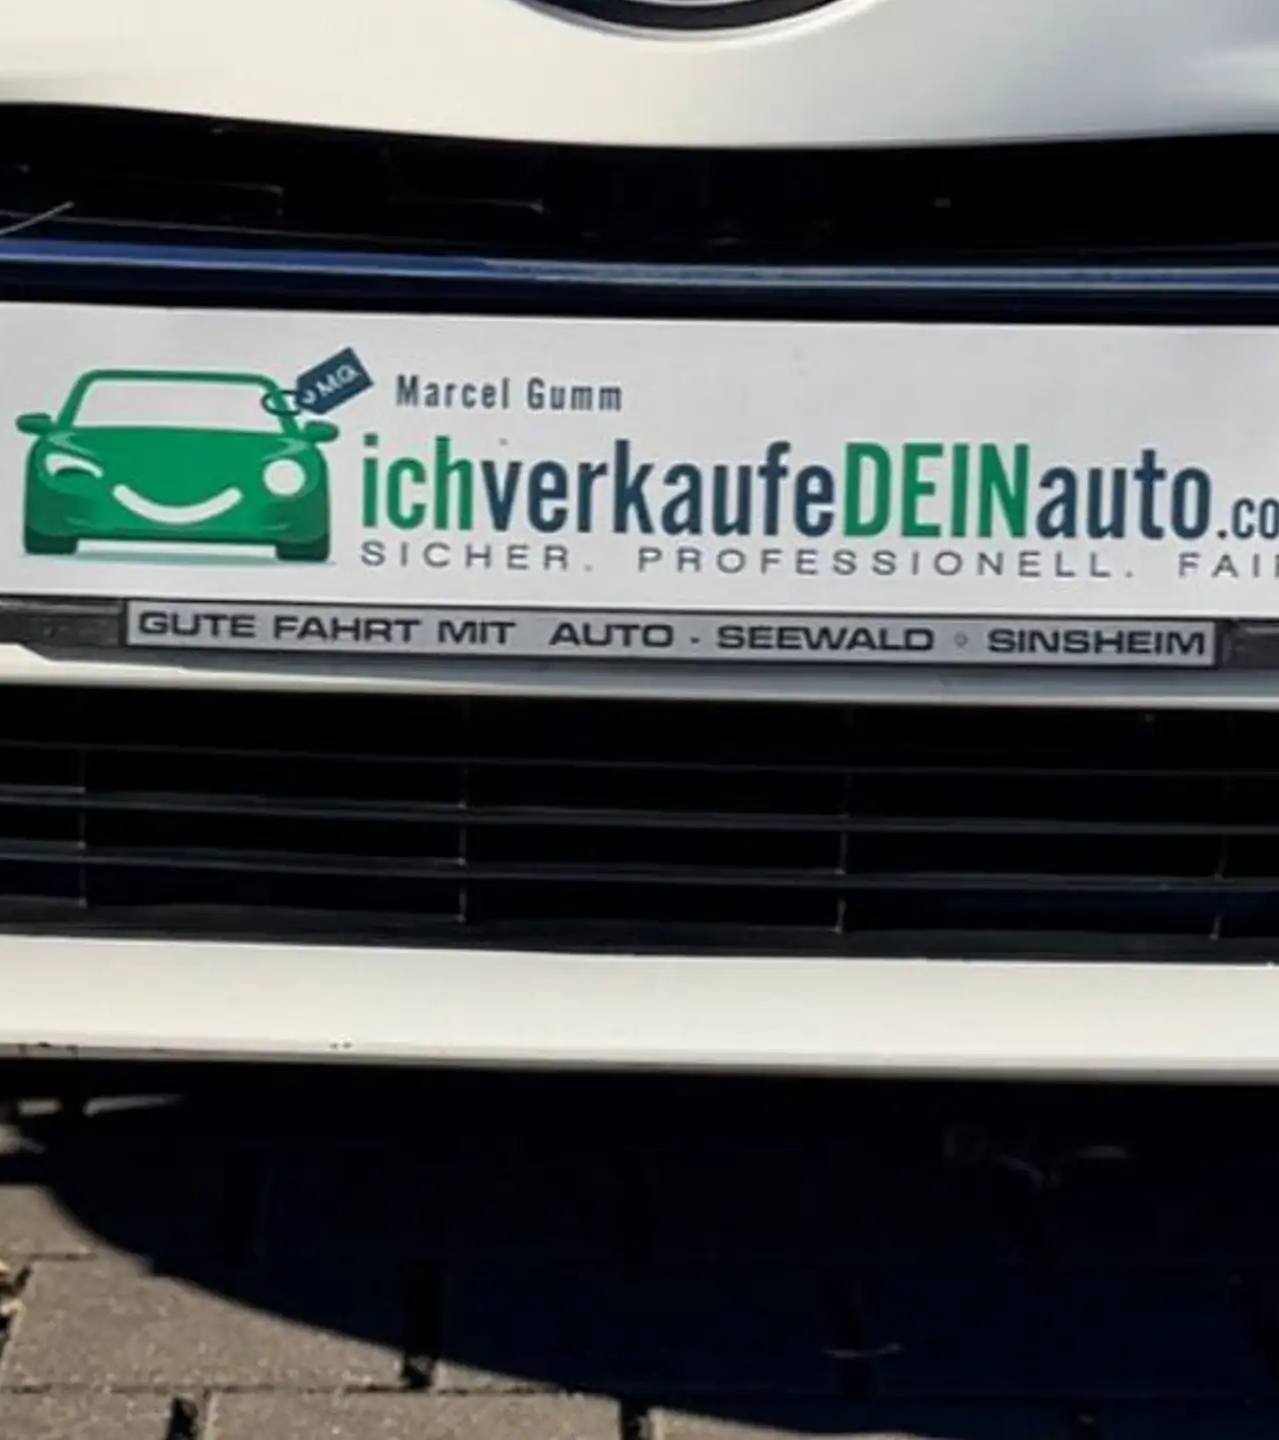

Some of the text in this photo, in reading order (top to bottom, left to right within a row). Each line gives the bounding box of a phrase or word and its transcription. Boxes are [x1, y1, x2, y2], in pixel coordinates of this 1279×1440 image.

[396, 374, 622, 410] Marcel Gumm
[361, 540, 594, 571] SICHER.
[638, 546, 1135, 578] PROFESSIONELL.
[137, 610, 1206, 656] GUTE FAHRT MIT AUTO SEEWALD SINSHEIM
